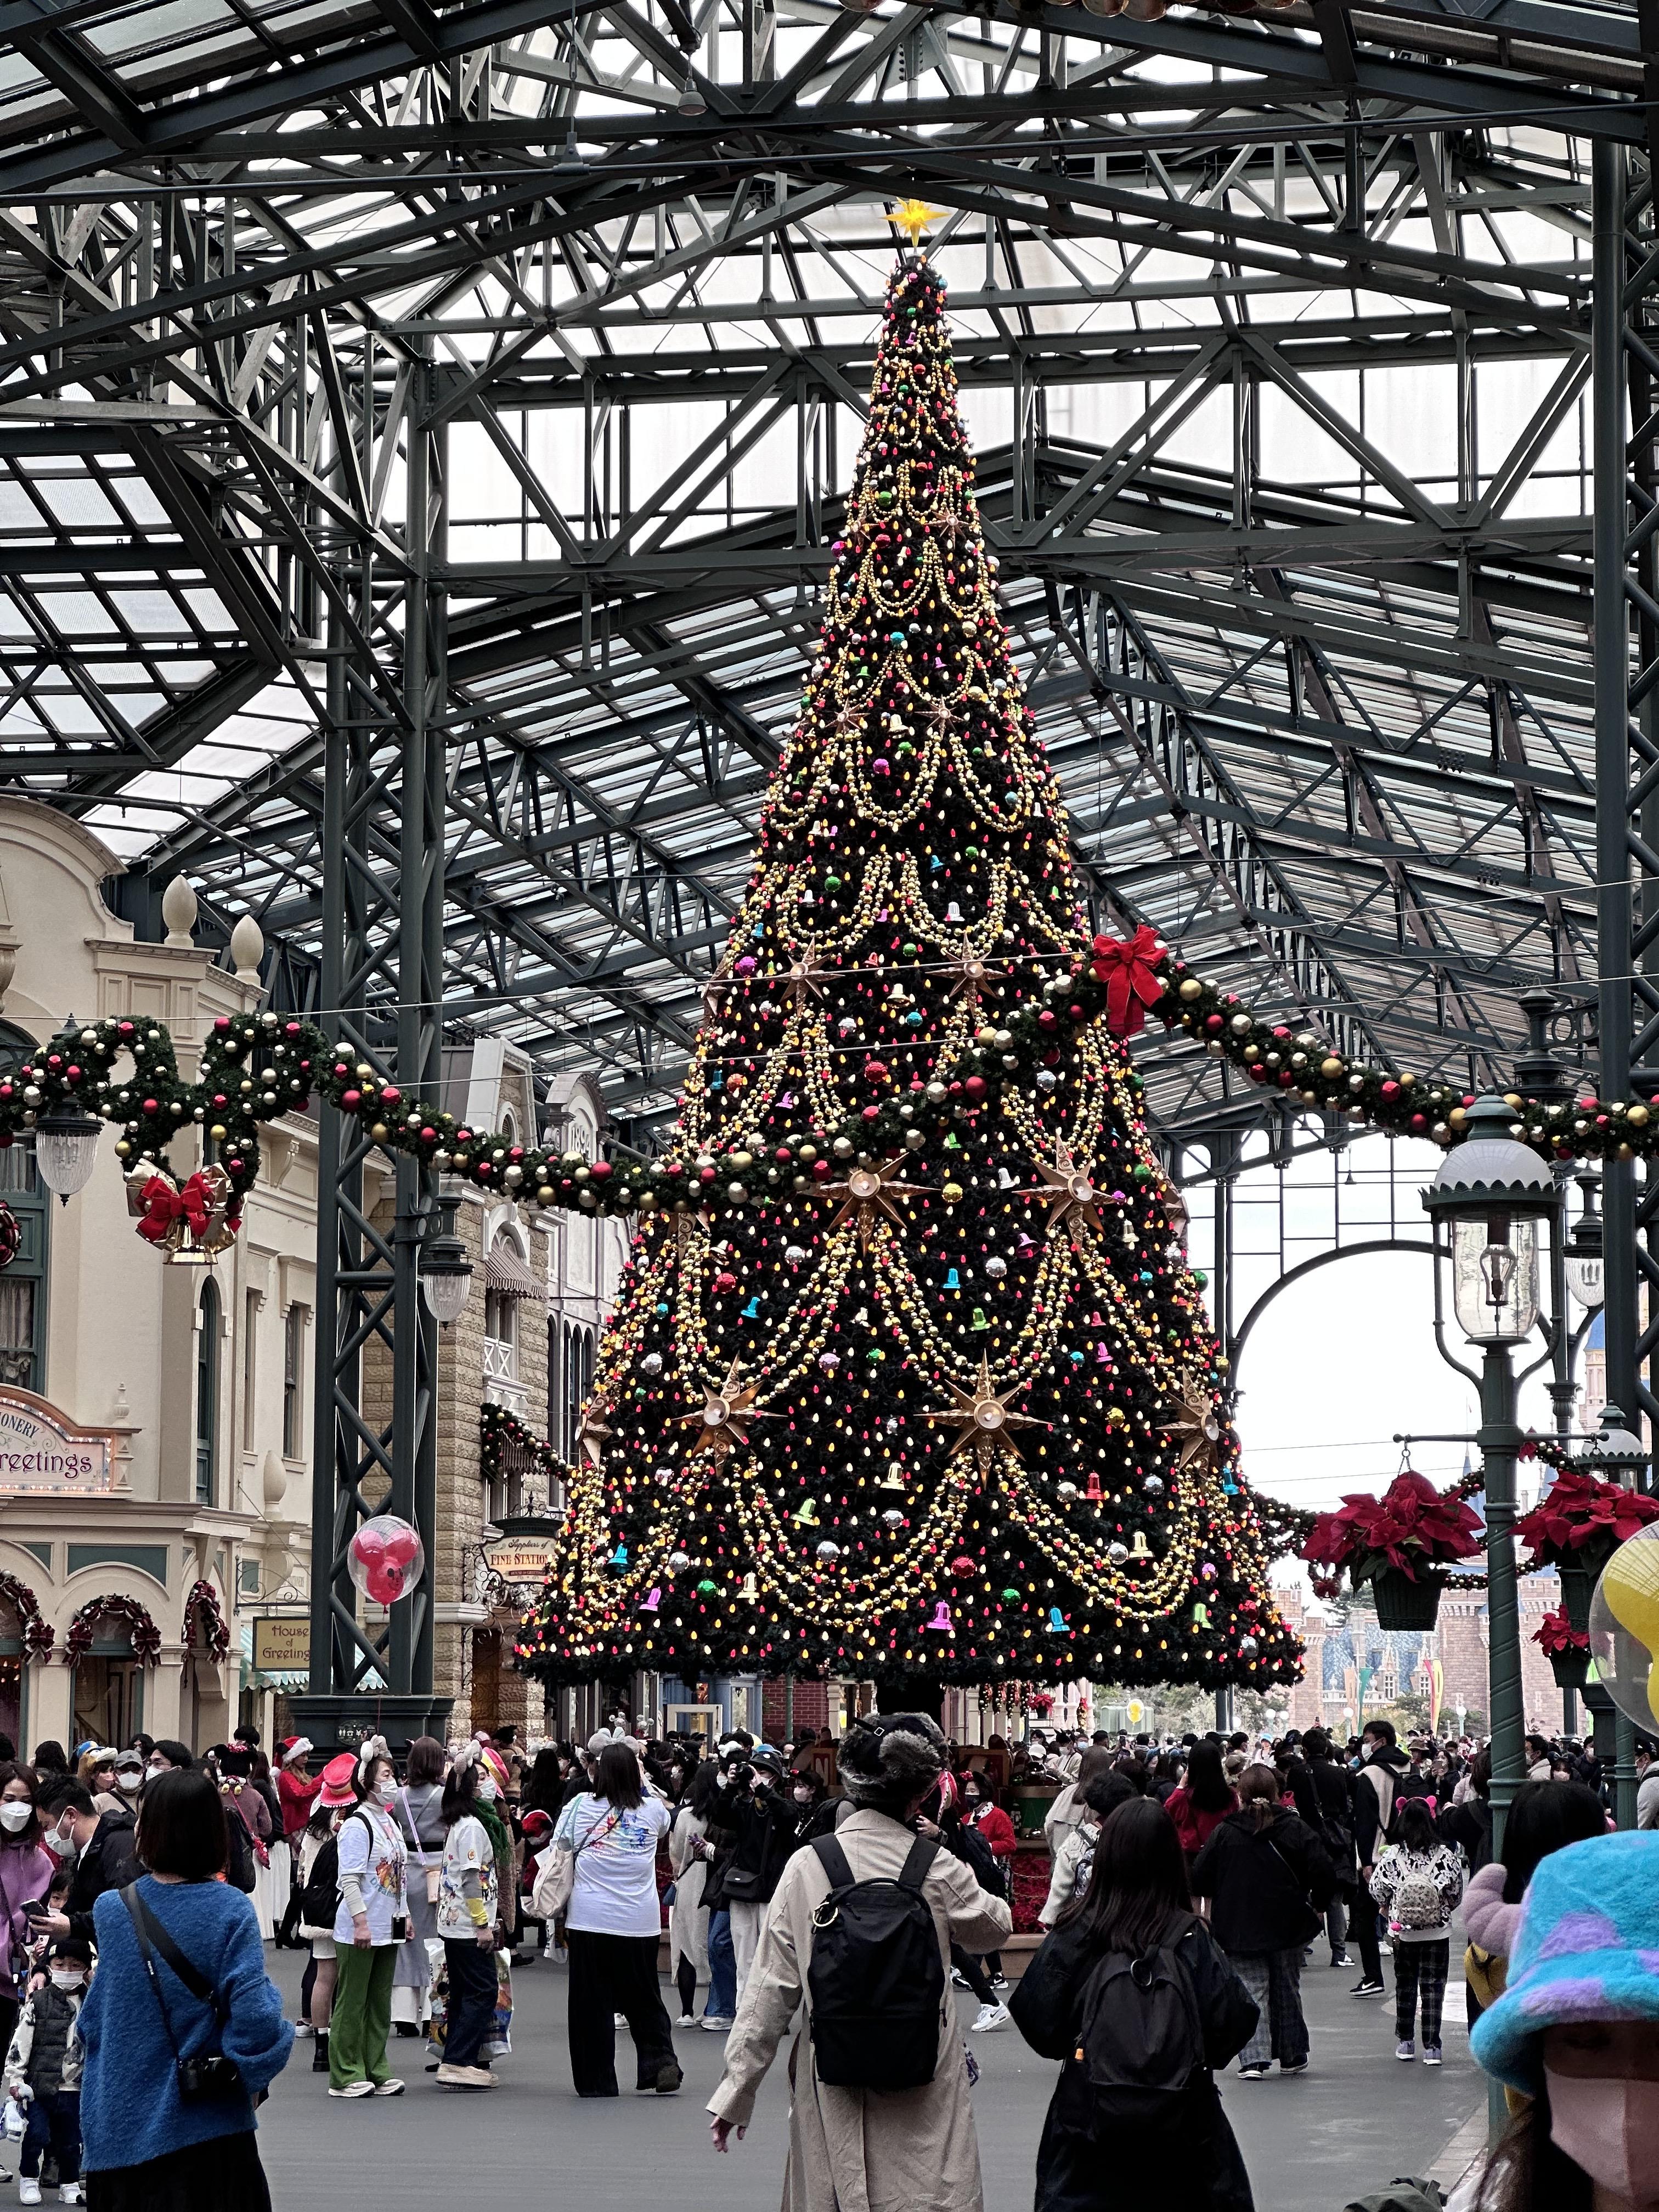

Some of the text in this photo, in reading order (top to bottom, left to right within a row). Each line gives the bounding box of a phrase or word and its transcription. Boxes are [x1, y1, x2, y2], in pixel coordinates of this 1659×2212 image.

[572, 1126, 591, 1159] 1894
[0, 1412, 40, 1438] ONERY
[508, 1539, 539, 1551] Suppliers
[490, 1554, 511, 1565] FINE
[272, 1625, 309, 1638] House
[286, 1638, 294, 1647] of
